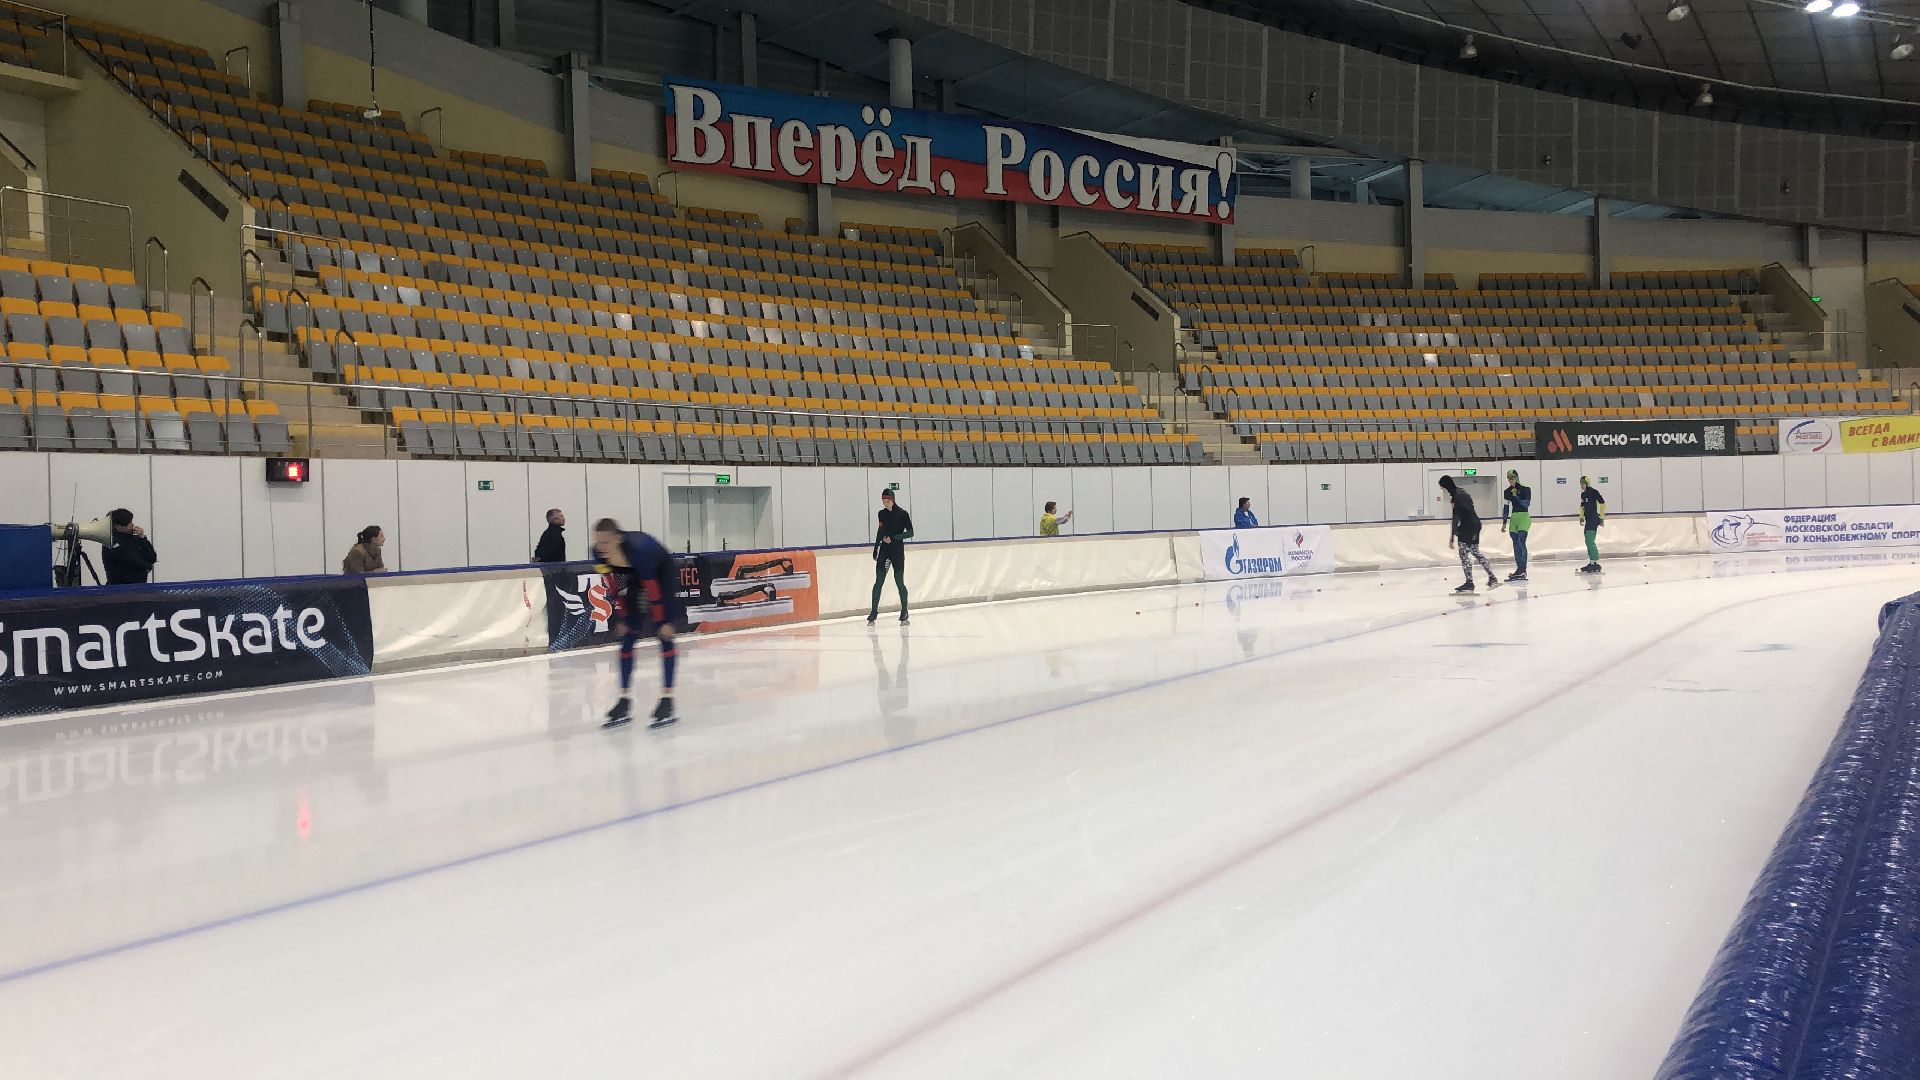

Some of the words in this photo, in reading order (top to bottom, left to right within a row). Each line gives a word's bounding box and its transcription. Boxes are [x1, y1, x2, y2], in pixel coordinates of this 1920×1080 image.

[668, 83, 957, 197] Вперёд,
[982, 124, 1235, 221] Россия!
[1848, 422, 1890, 437] ВСЕГДА
[1577, 433, 1628, 447] ВКУСНО
[1653, 432, 1698, 446] ТОЧКА
[1783, 513, 1837, 523] ФЕДЕРАЦИЯ
[1784, 521, 1848, 533] МОСКОВСКОЙ
[1850, 522, 1894, 531] ОБЛАСТИ
[1785, 534, 1800, 544] ПО
[1803, 532, 1888, 543] КОНЬКОБЕЖНОМУ
[1242, 557, 1282, 573] ГАЗПРОМ
[0, 603, 327, 678] martSkate
[53, 670, 224, 696] WWW.SMARTSKATE.COM
